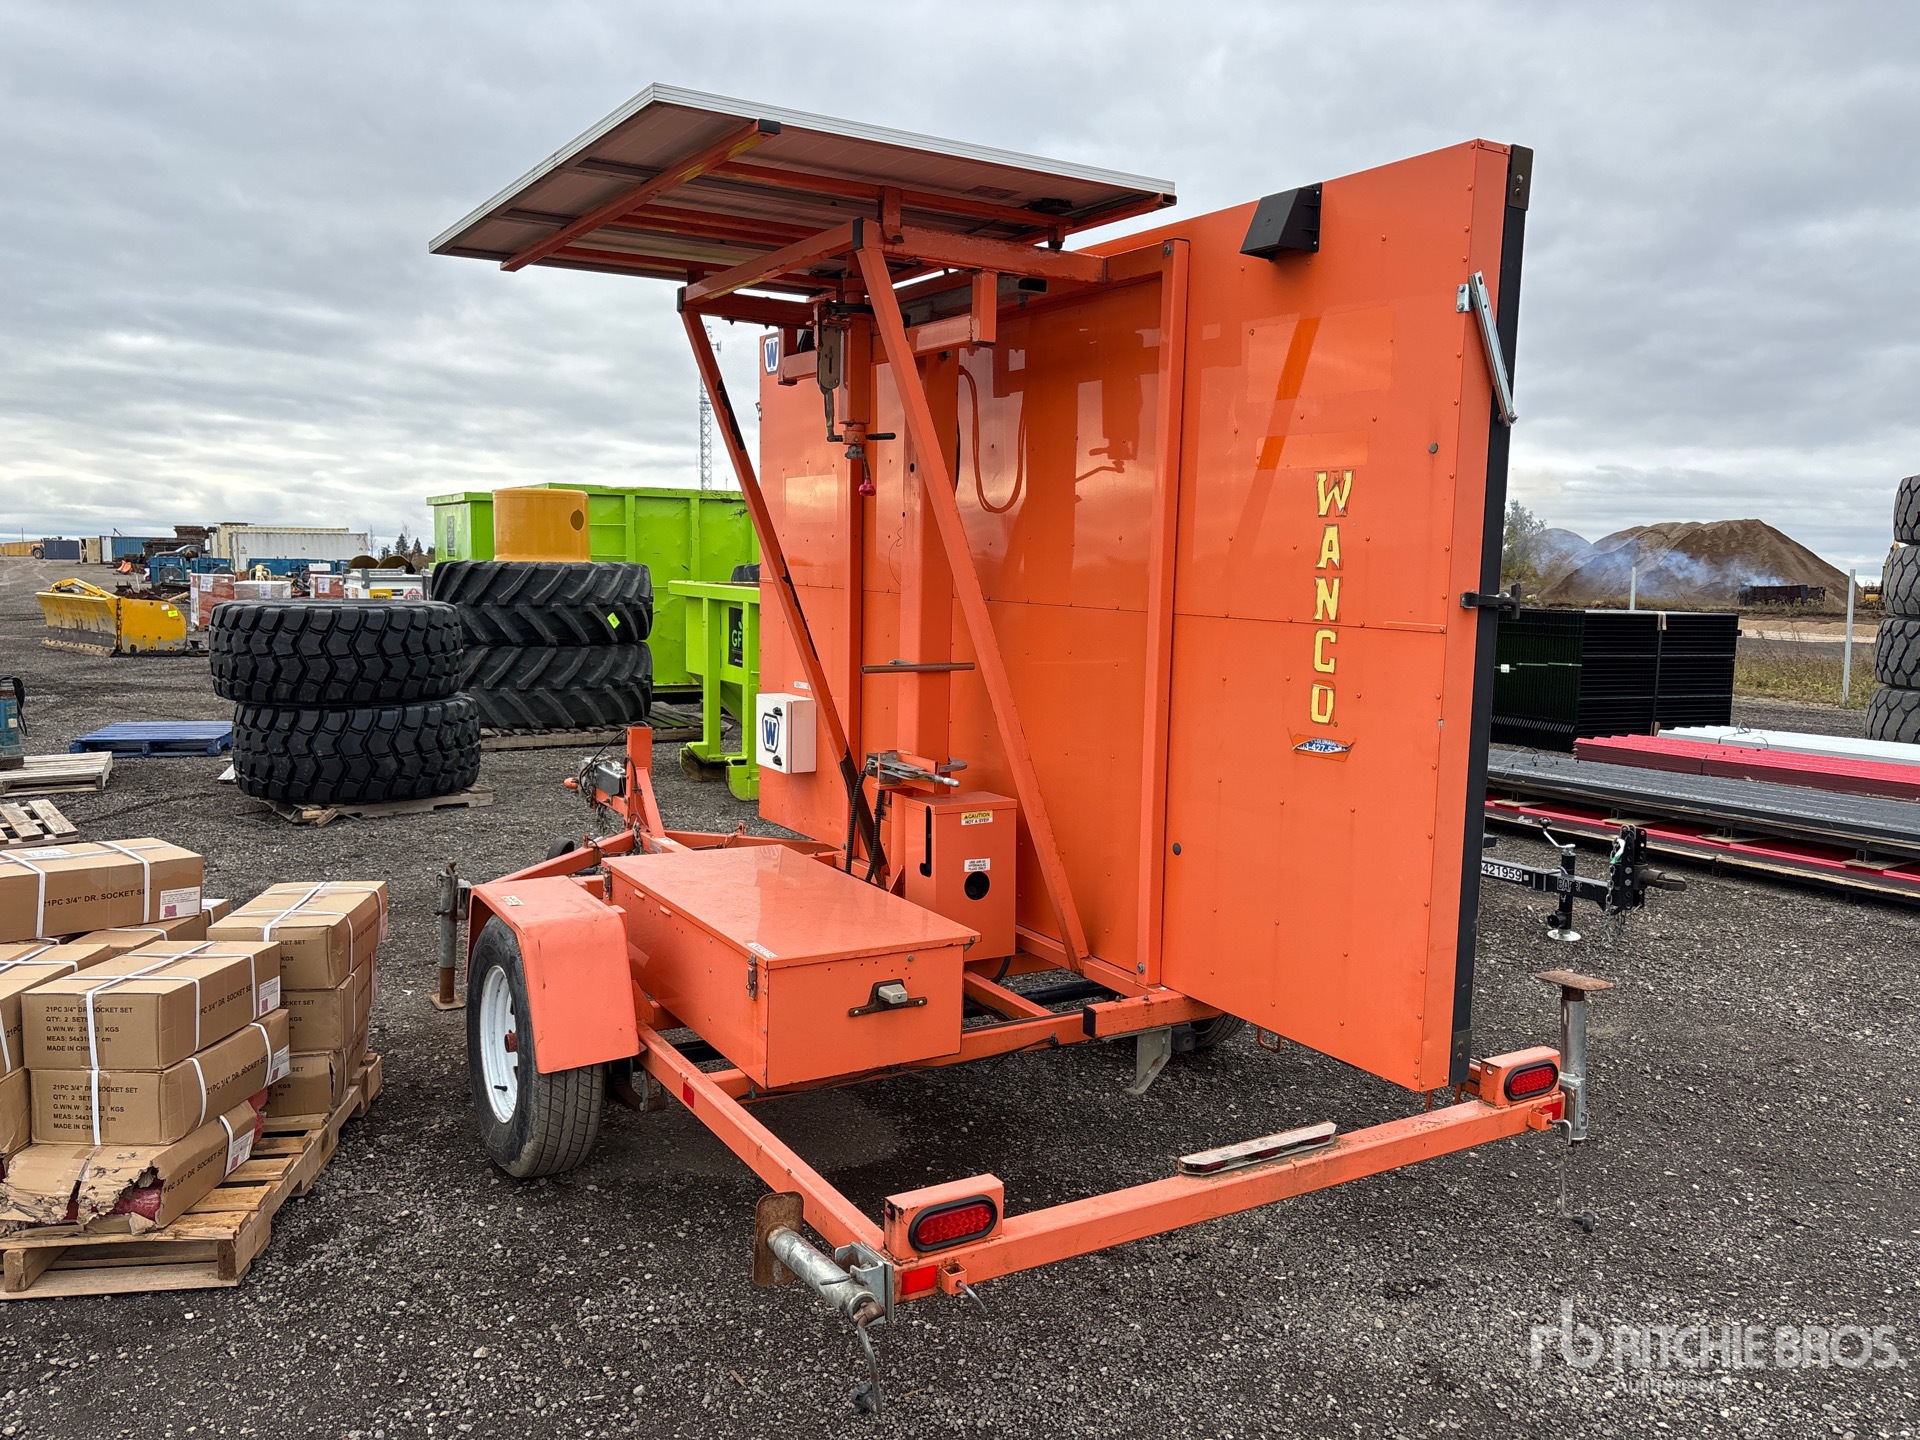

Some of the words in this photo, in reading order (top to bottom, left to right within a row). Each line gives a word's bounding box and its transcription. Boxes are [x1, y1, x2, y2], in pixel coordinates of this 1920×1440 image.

[764, 719, 777, 747] W
[101, 889, 134, 900] SOCKET
[226, 987, 245, 1003] SOCKET
[206, 1083, 220, 1095] 21PC
[240, 1059, 260, 1076] SOCKET
[197, 1151, 217, 1171] SOCKET
[217, 1145, 227, 1157] SET
